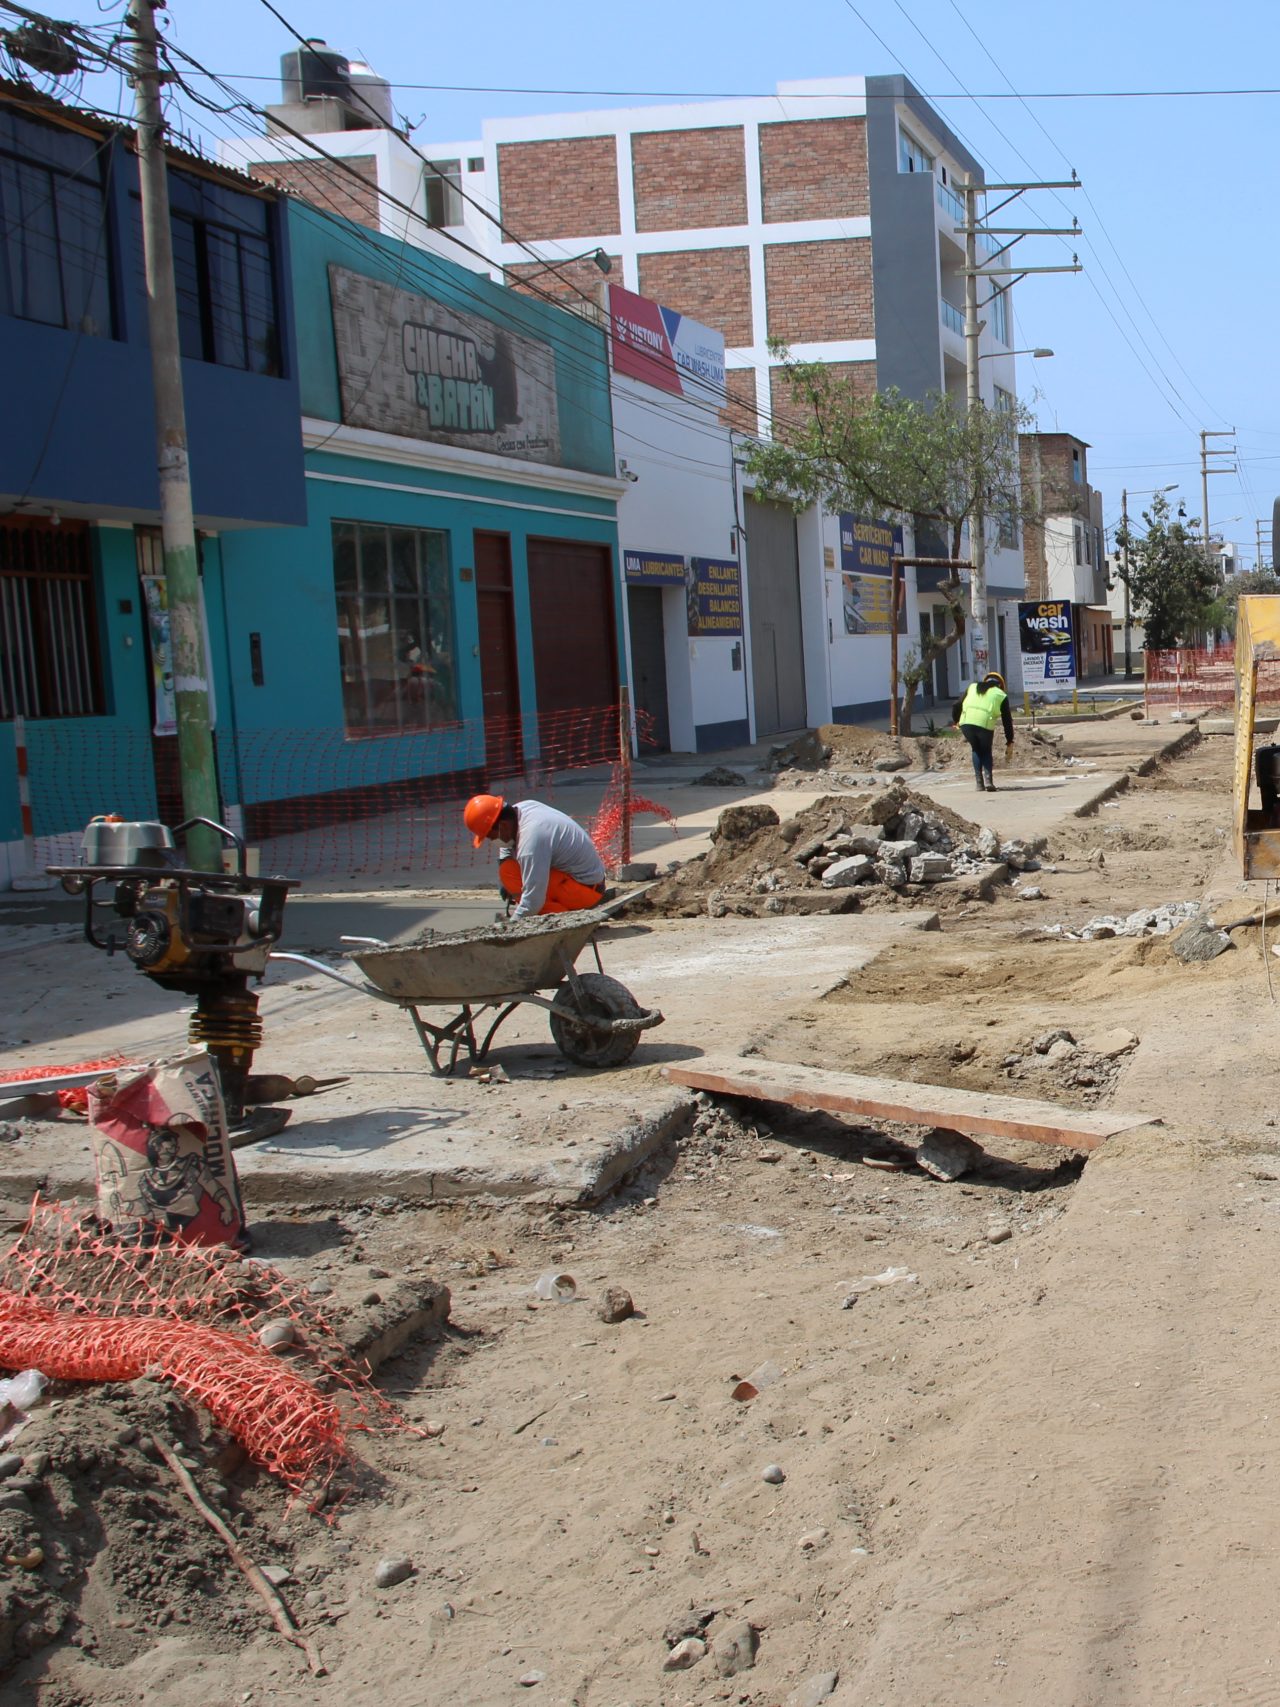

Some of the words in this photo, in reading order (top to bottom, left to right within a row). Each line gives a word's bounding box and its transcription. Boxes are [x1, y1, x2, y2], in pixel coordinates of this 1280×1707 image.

[629, 320, 663, 351] VISTONY
[403, 322, 482, 381] CHICHA
[853, 522, 893, 547] SERVICENTRO
[859, 546, 872, 565] CAR
[872, 549, 890, 568] WASH
[626, 556, 641, 571] UMA
[642, 560, 684, 577] LUBRICANTES
[708, 565, 738, 580] ENLLANTE
[698, 581, 738, 596] DESENLLANTE
[709, 599, 739, 613] BALANCEO
[1038, 604, 1063, 616] car
[698, 615, 740, 629] ALINEAMIENTO
[1026, 615, 1069, 630] wash
[195, 1072, 225, 1176] MOCHICA
